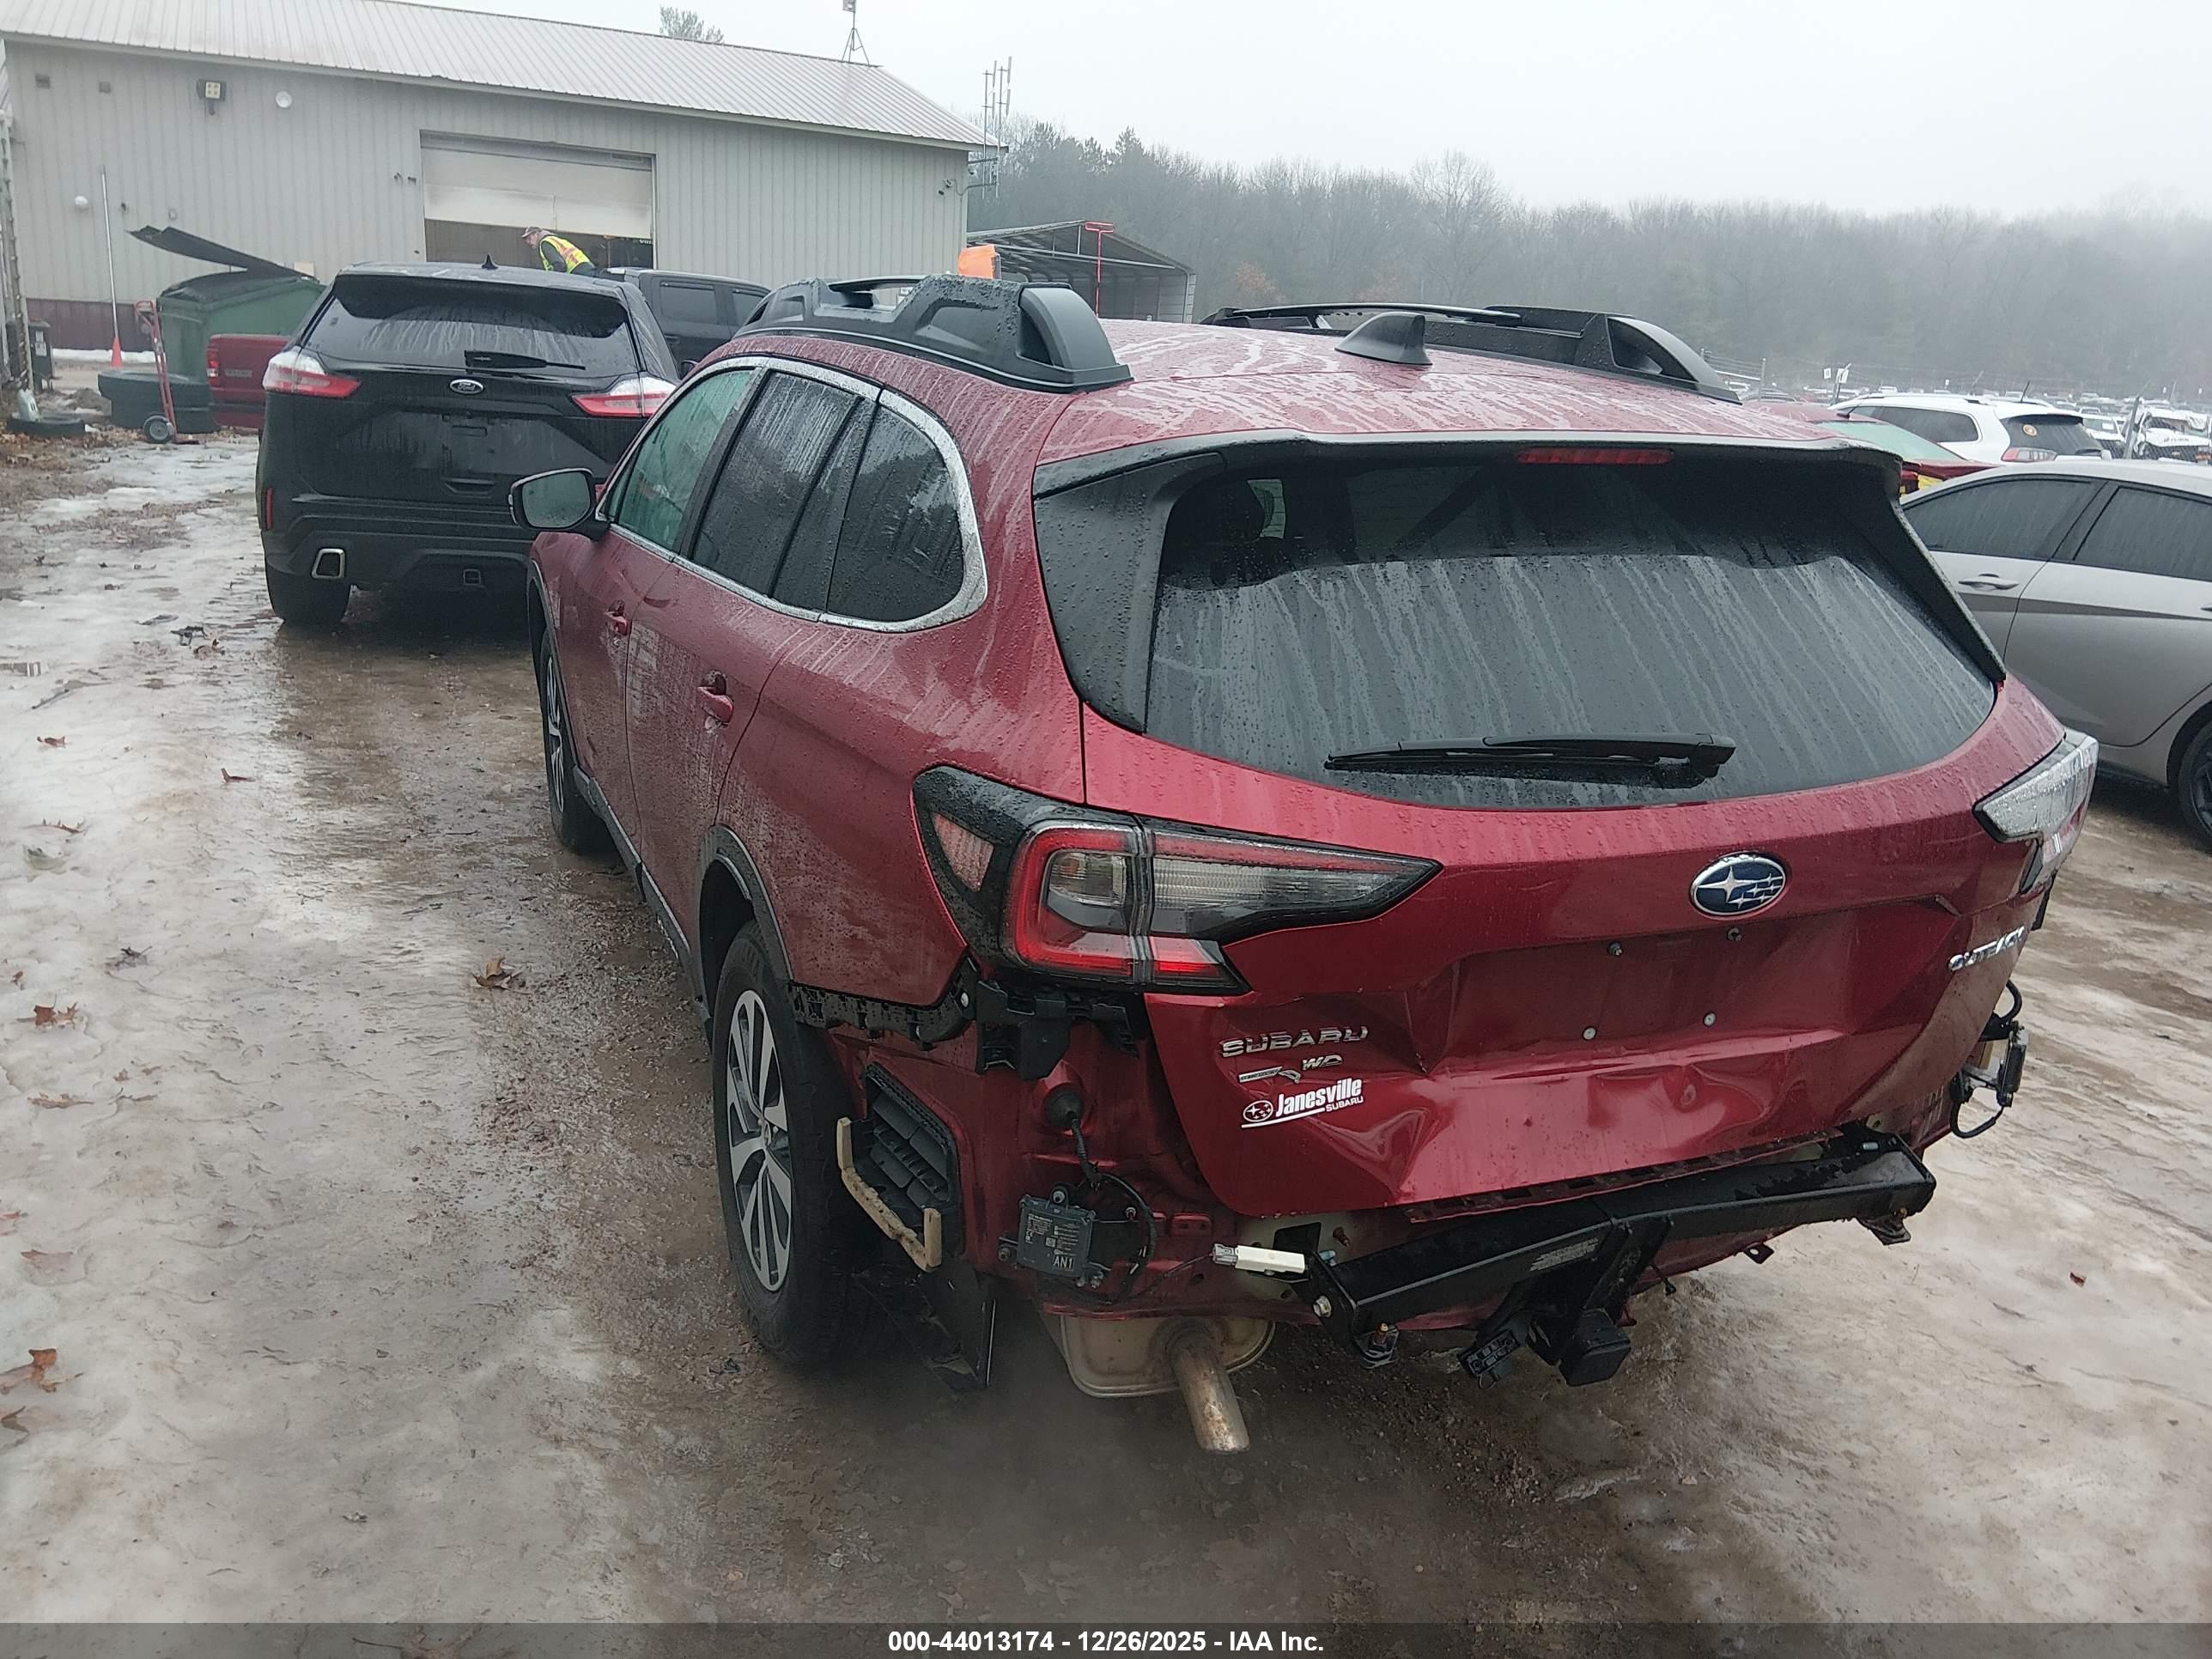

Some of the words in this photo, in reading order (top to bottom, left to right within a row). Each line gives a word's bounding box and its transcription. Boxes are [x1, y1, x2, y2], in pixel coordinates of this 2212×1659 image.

[1220, 1025, 1369, 1057] SUBARU
[1275, 1078, 1363, 1117] Janesville
[1325, 1096, 1364, 1112] SUBARU
